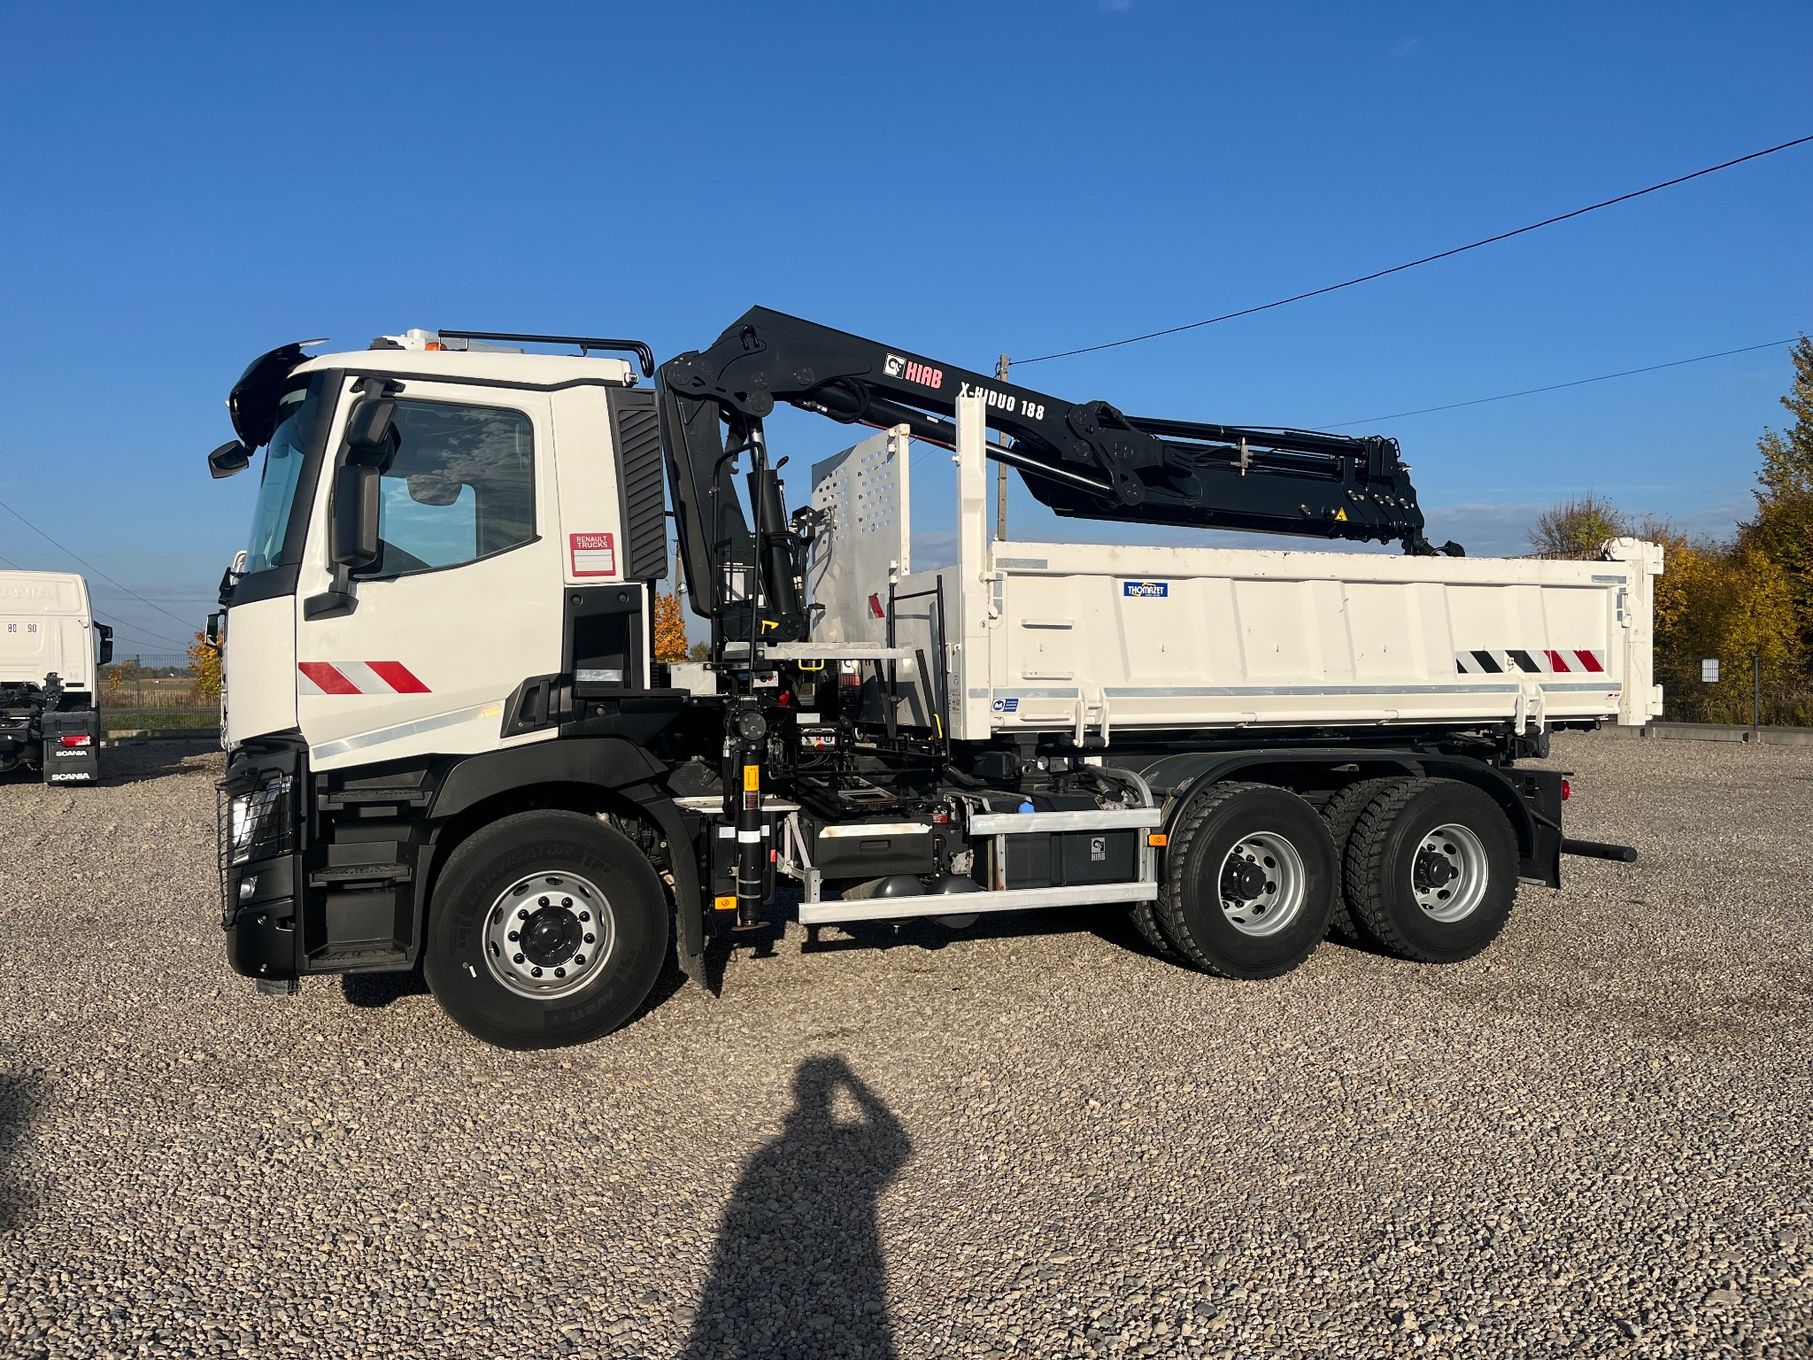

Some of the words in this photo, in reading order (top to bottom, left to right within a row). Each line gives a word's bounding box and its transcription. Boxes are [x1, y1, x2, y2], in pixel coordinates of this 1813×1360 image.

[905, 361, 944, 389] HIAB
[959, 381, 1016, 412] X-HIDUO
[1021, 400, 1045, 421] 188
[576, 535, 607, 543] RENAULT
[1127, 585, 1165, 595] THOMAZET
[7, 623, 17, 633] 80
[27, 623, 37, 633] 90
[51, 772, 91, 781] SCANIA
[1091, 852, 1106, 861] HIAB
